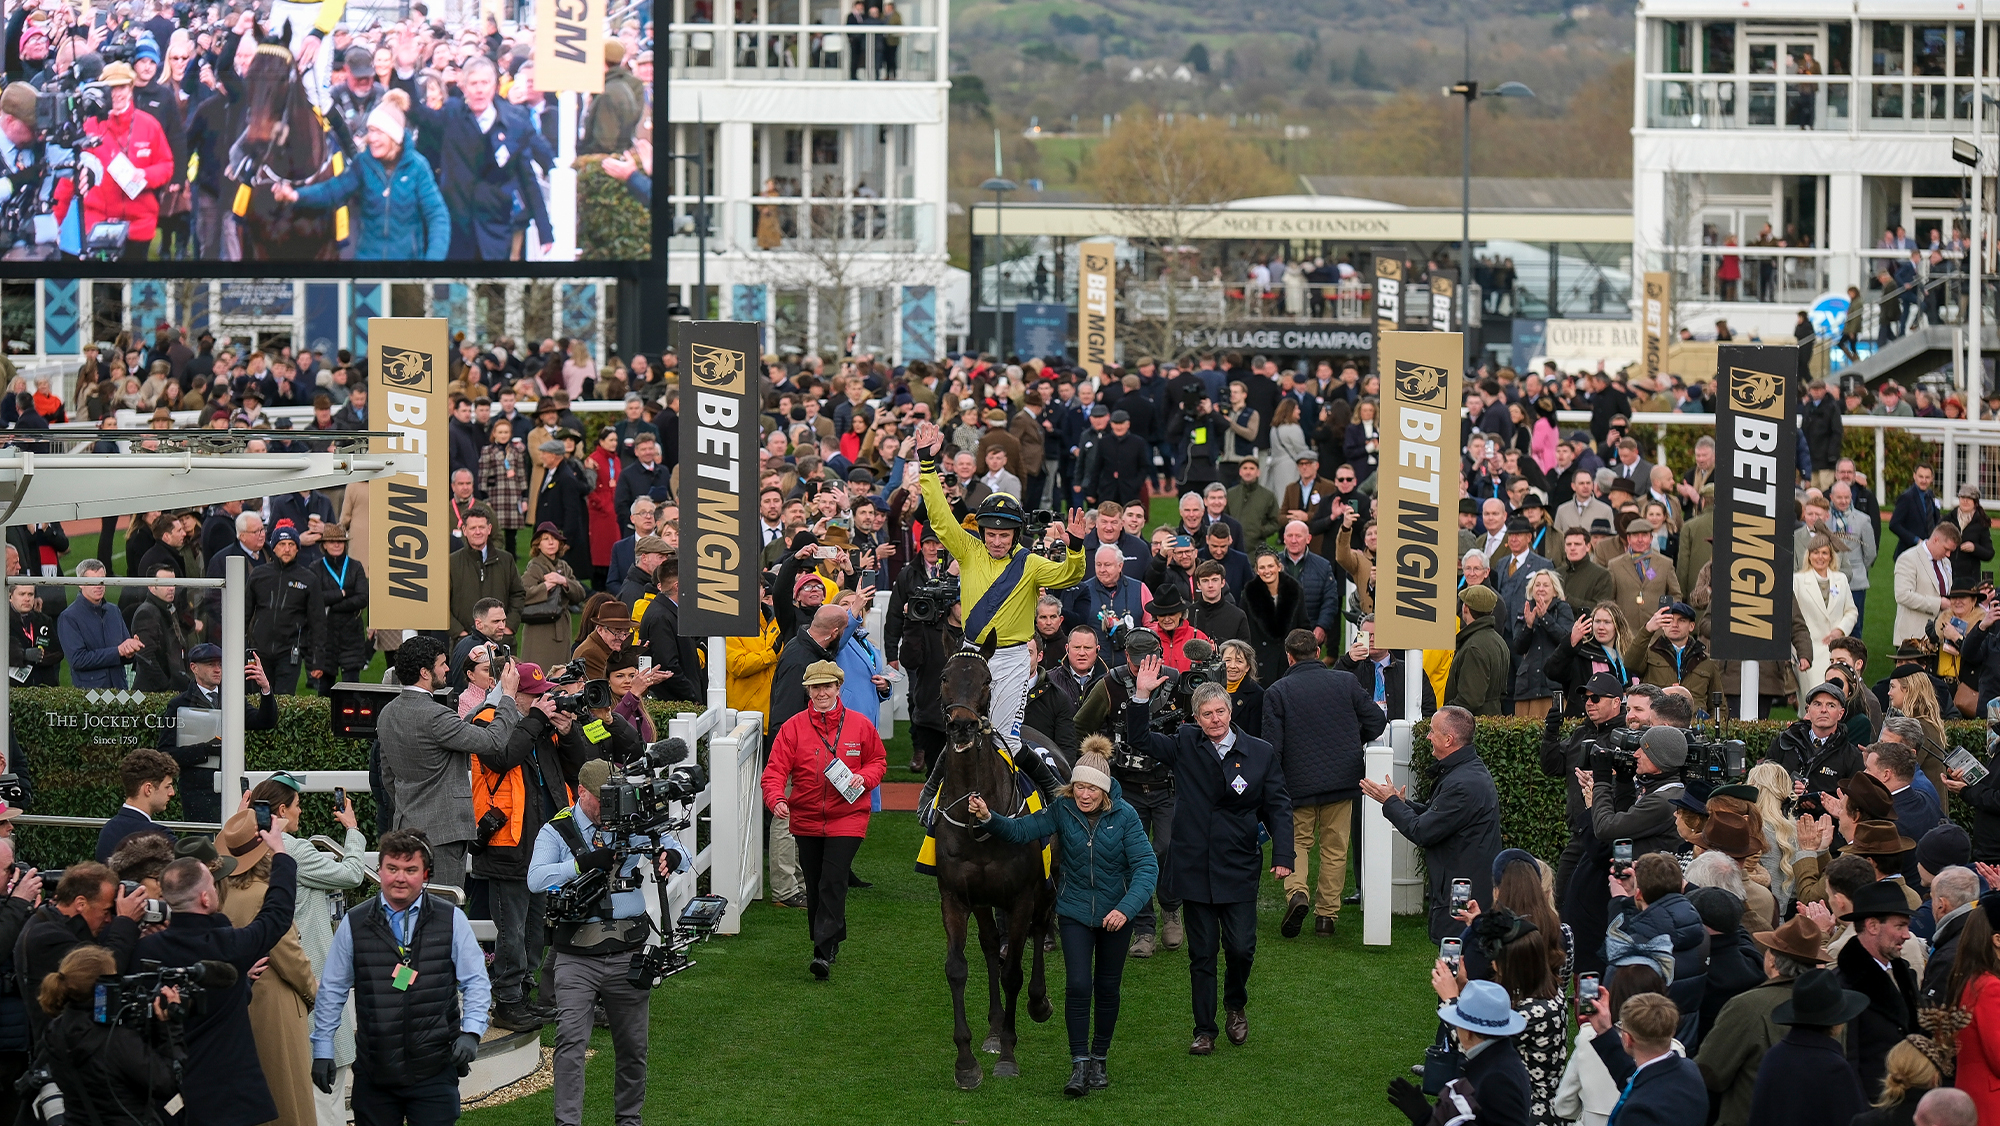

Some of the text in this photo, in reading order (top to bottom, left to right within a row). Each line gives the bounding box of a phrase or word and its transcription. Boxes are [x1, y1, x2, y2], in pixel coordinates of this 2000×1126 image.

[1280, 218, 1292, 232] &
[1296, 219, 1389, 233] CHANDON
[1087, 273, 1107, 365] BETMGM
[1432, 294, 1450, 332] BET
[1204, 330, 1281, 348] VILLAGE
[1283, 331, 1373, 349] CHAMPAG
[1553, 328, 1605, 346] COFFEE
[1612, 329, 1639, 346] BAR
[697, 391, 740, 616] BETMGM
[1396, 406, 1442, 623] BETMGM
[1730, 415, 1778, 640] BETMGM
[1015, 679, 1029, 720] Brown
[93, 735, 138, 745] Since 1750
